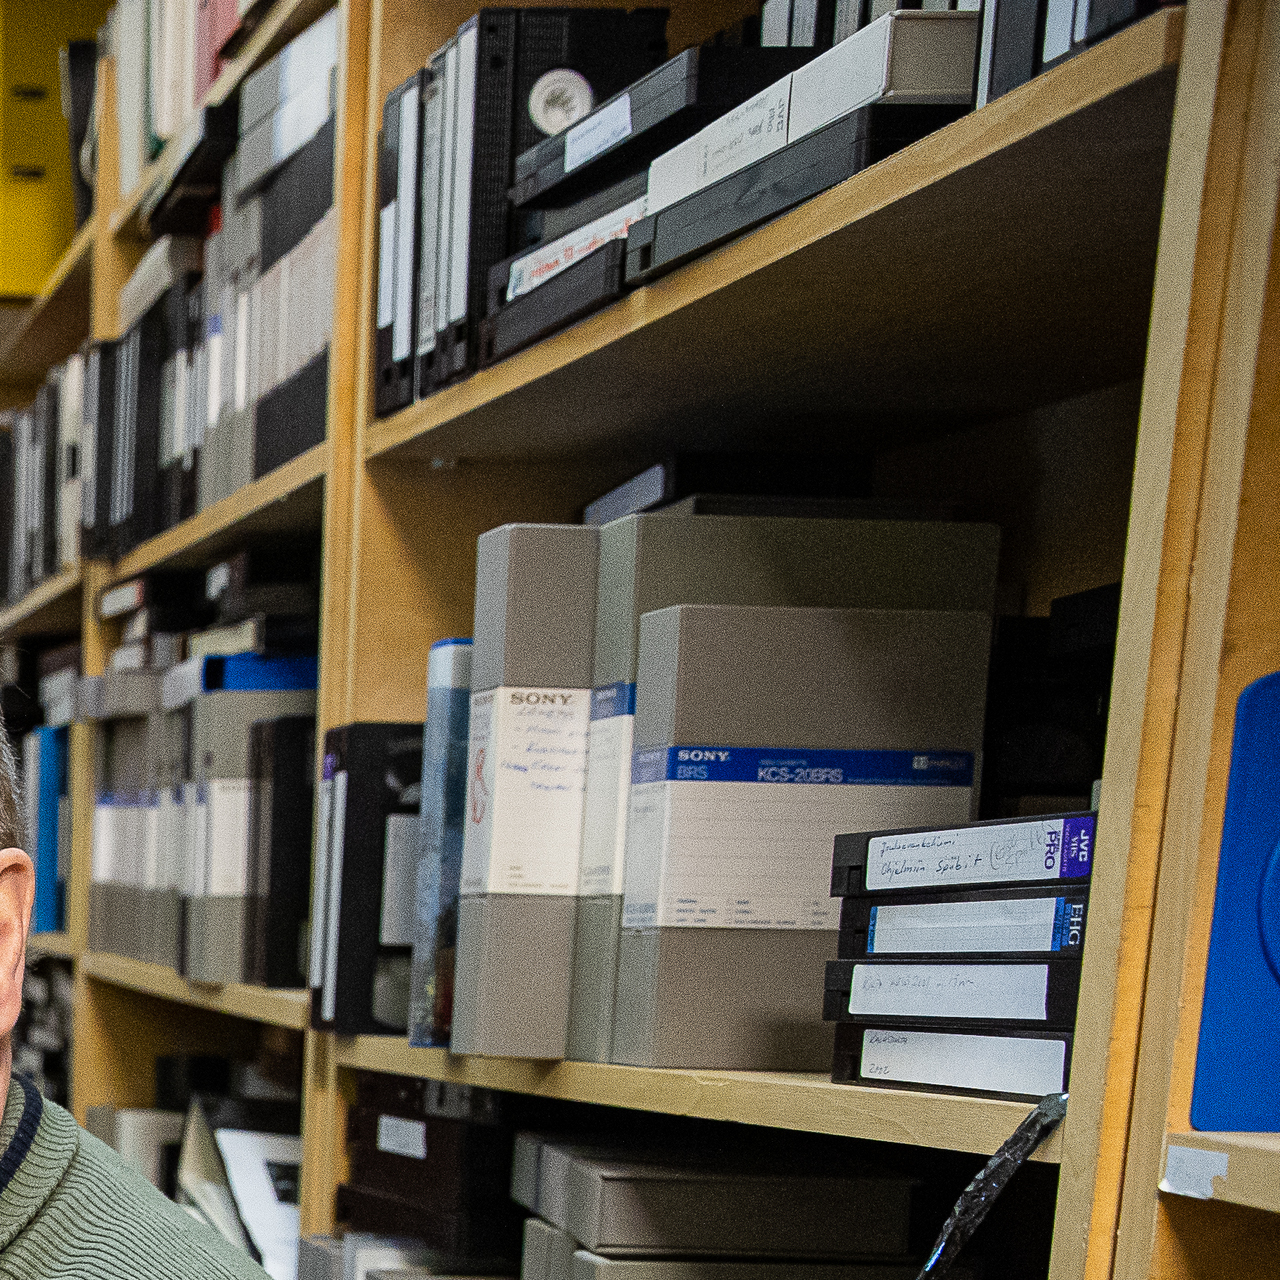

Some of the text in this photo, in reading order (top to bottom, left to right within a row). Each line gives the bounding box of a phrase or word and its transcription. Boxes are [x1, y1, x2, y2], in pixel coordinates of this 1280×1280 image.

[509, 691, 573, 705] SONY
[676, 749, 730, 762] SONY
[675, 765, 709, 780] BRS
[1043, 830, 1060, 871] PRO
[1079, 829, 1090, 863] JVC
[1068, 904, 1084, 946] EHG
